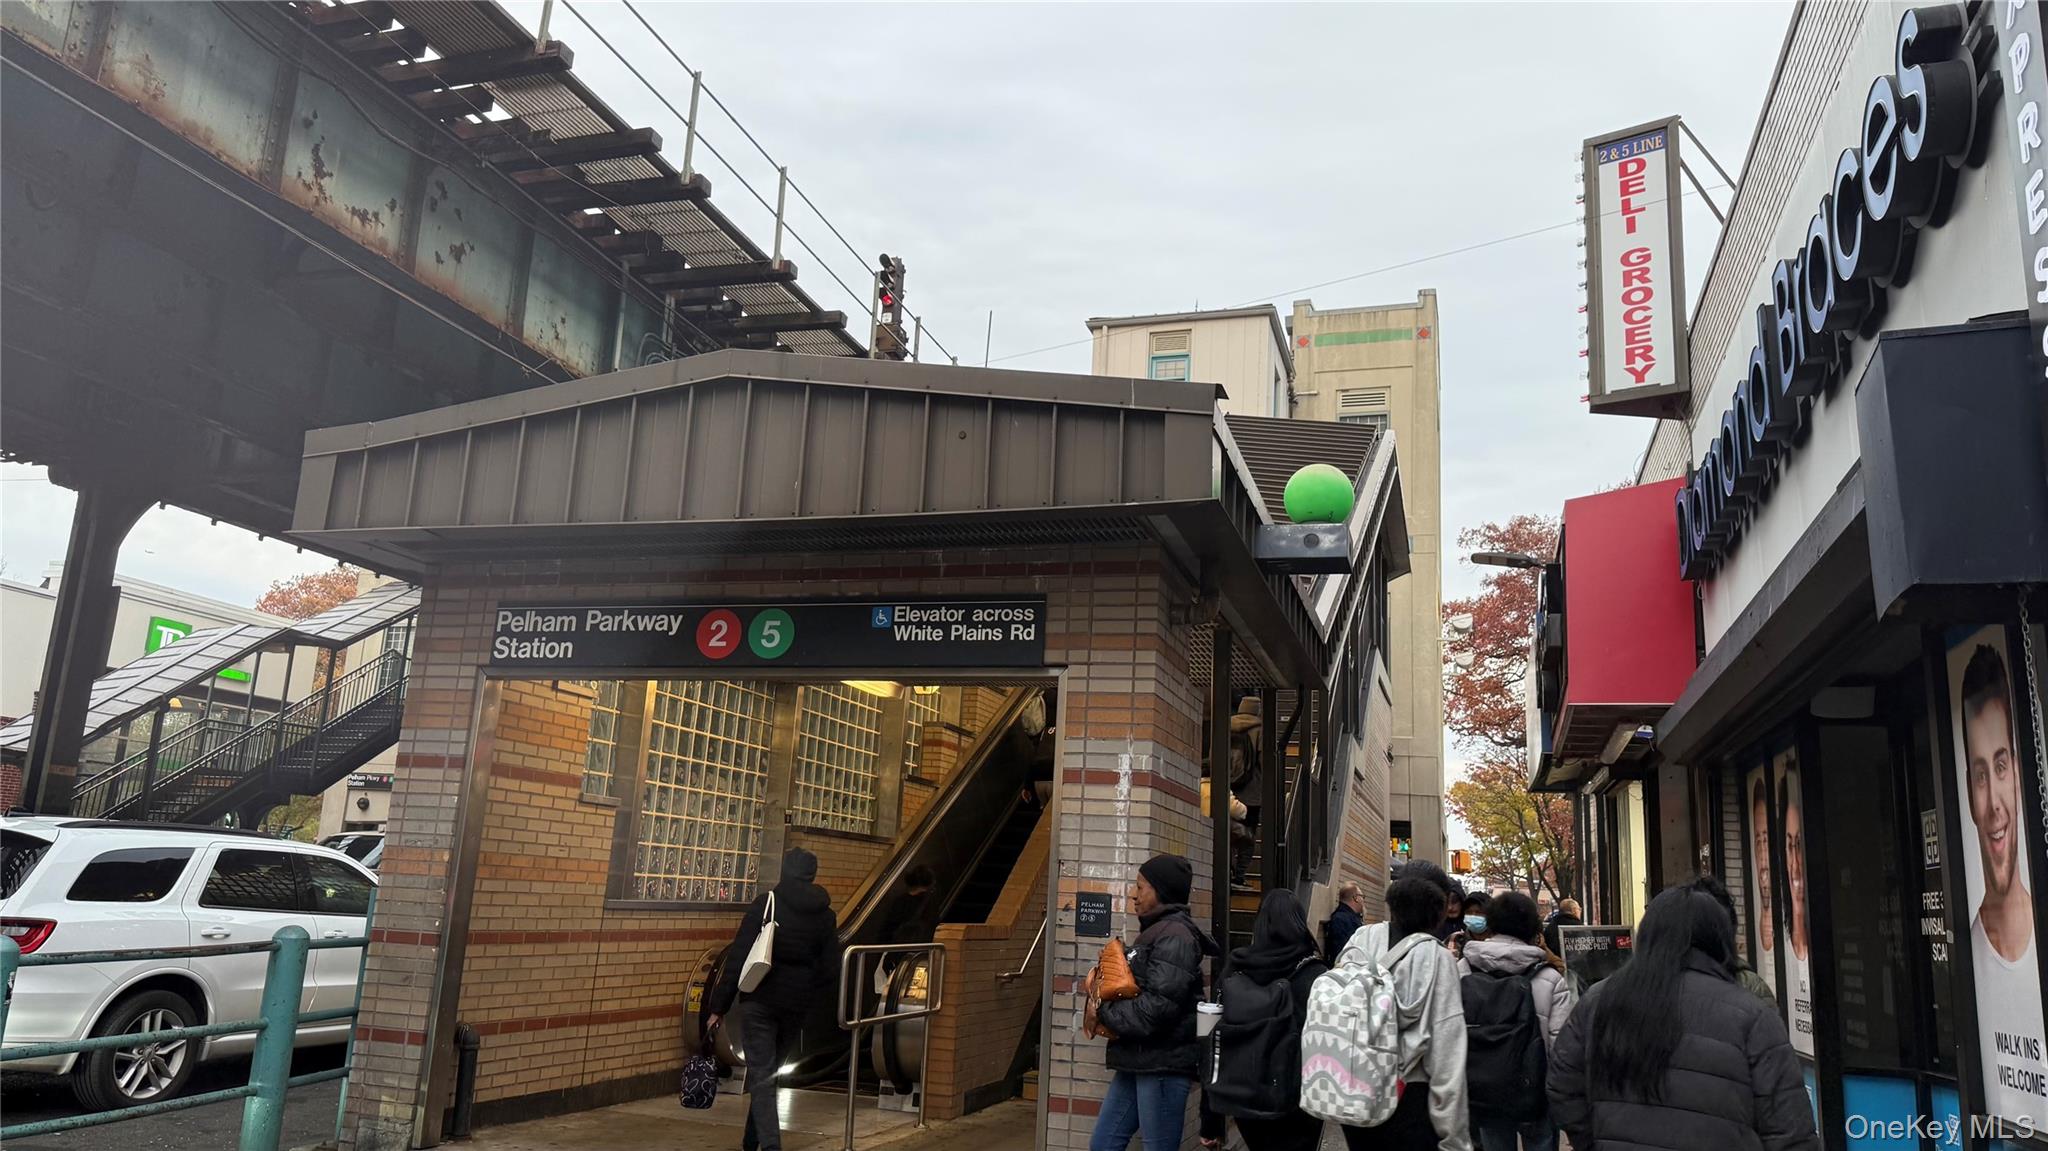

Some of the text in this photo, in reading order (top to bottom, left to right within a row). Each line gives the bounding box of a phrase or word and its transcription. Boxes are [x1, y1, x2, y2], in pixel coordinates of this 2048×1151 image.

[1600, 135, 1663, 163] 2 & 5 LINE
[1618, 157, 1646, 234] DELI
[1772, 8, 1940, 396] Braces
[1620, 247, 1656, 384] GROCERY
[496, 609, 683, 636] Pelham Parkway
[894, 606, 1034, 622] Elevator across
[894, 624, 1035, 641] White Plains Rd
[493, 636, 574, 659] Station
[1922, 892, 1940, 910] FREE
[1575, 936, 1595, 944] HIGHER
[1596, 936, 1611, 944] WITH
[1593, 942, 1609, 950] PILOT
[1995, 1031, 2040, 1061] WALK INS
[1997, 1063, 2047, 1098] WELCOME
